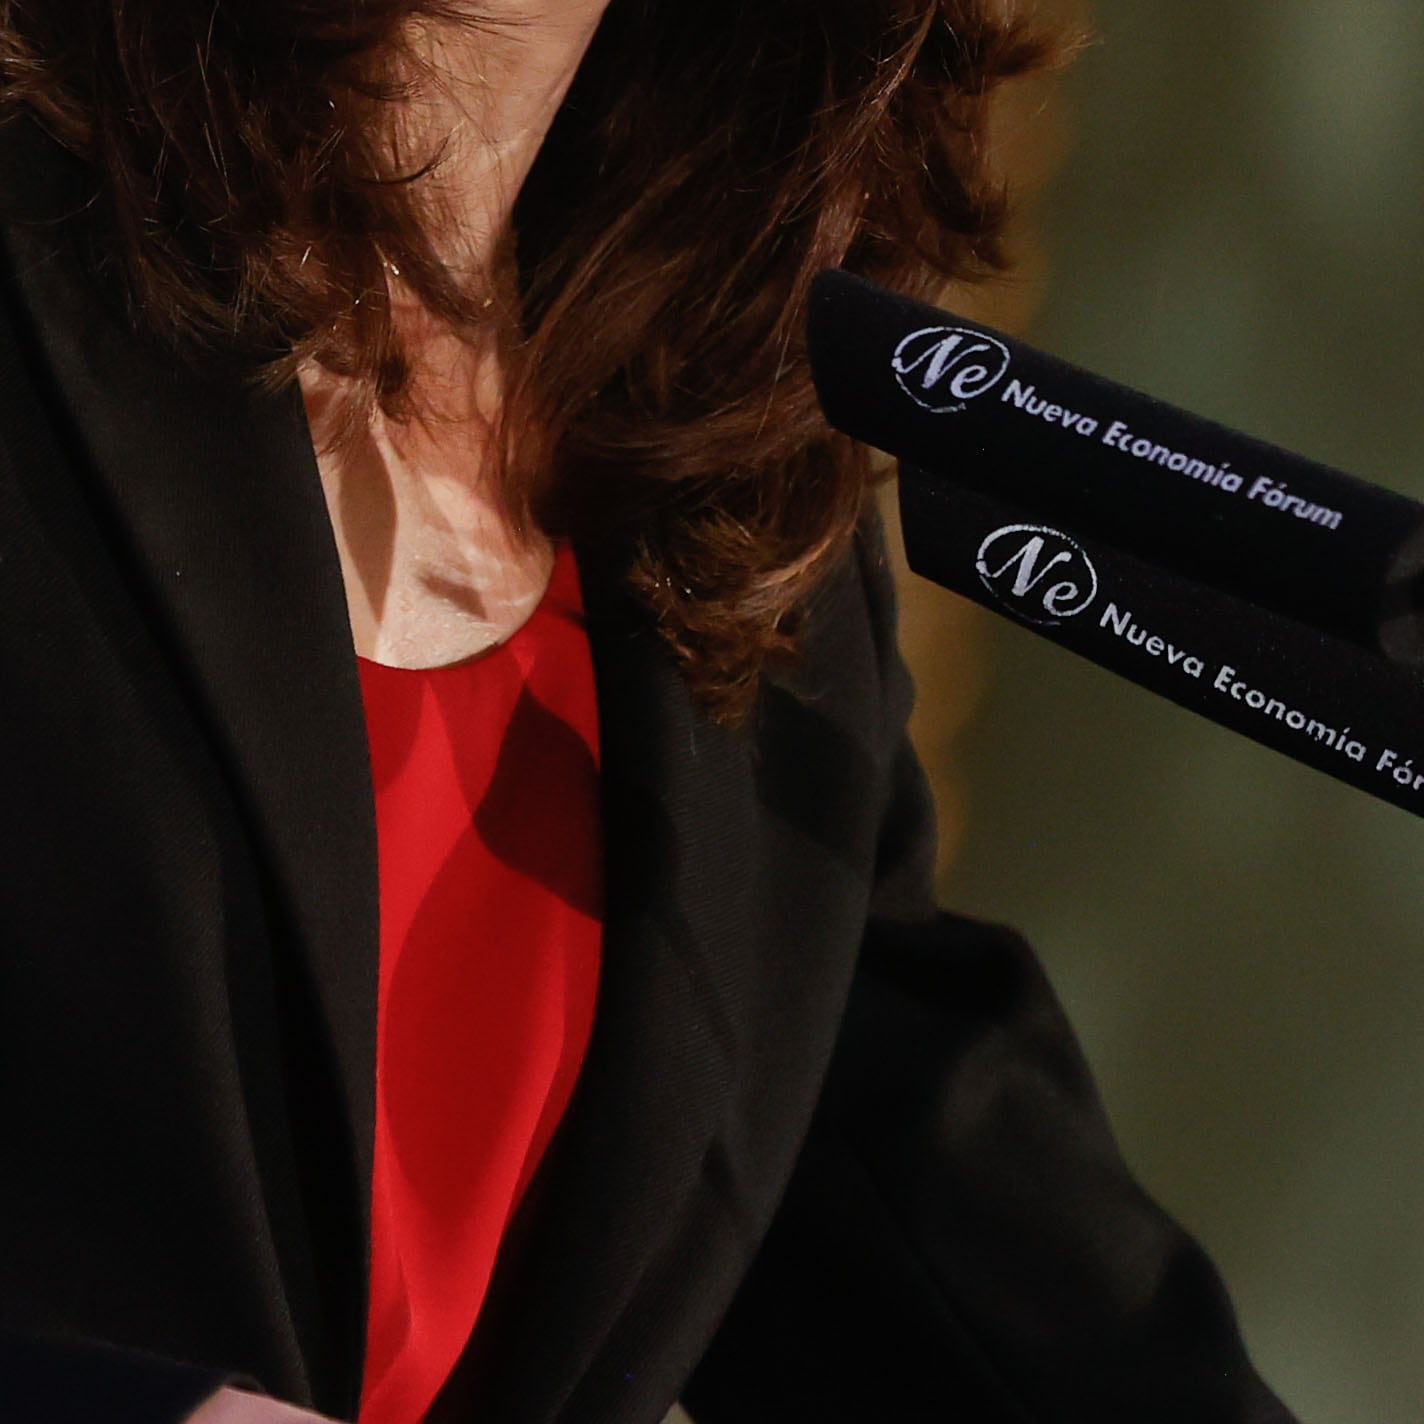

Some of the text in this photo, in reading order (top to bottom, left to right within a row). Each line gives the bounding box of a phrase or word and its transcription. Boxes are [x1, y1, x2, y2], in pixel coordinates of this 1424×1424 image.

[1001, 379, 1343, 530] Nueva Economía Fórum
[1099, 602, 1205, 678] Nueva
[1213, 665, 1367, 762] Economía
